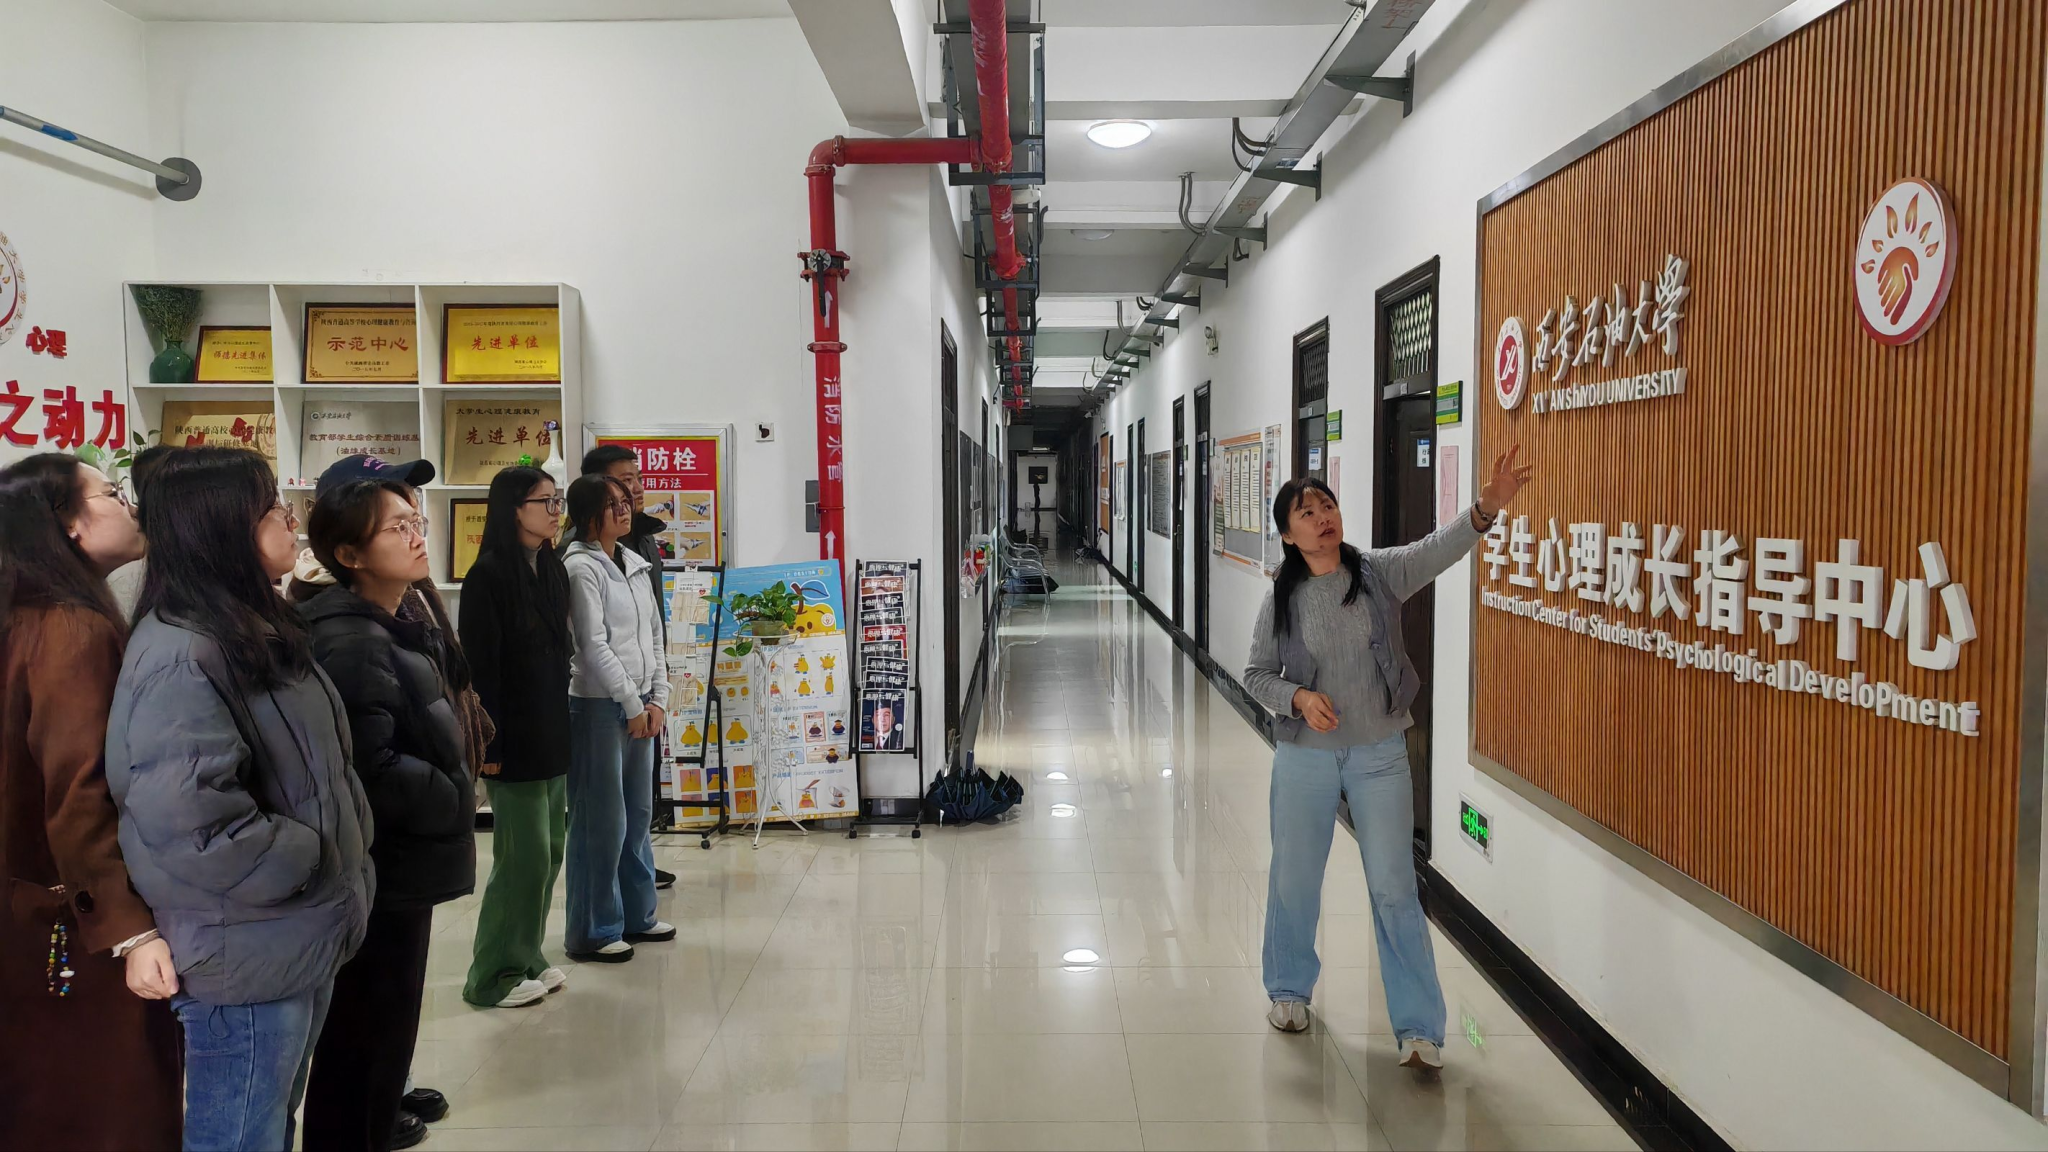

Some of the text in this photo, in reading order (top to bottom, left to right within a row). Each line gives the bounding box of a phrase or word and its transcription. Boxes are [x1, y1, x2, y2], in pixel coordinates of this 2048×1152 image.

[26, 326, 67, 359] 心理
[327, 336, 408, 352] 示范中心
[472, 334, 539, 351] 先进单位
[0, 380, 126, 449] 之动力
[456, 408, 540, 416] 大学生心理健康教育
[466, 426, 551, 448] 先进单位
[823, 376, 842, 483] 消防水管
[1483, 509, 1977, 671] 学生心理成长指导中心
[1481, 586, 1532, 617] Instruction
[1531, 599, 1569, 628] Center
[1569, 608, 1589, 634] for
